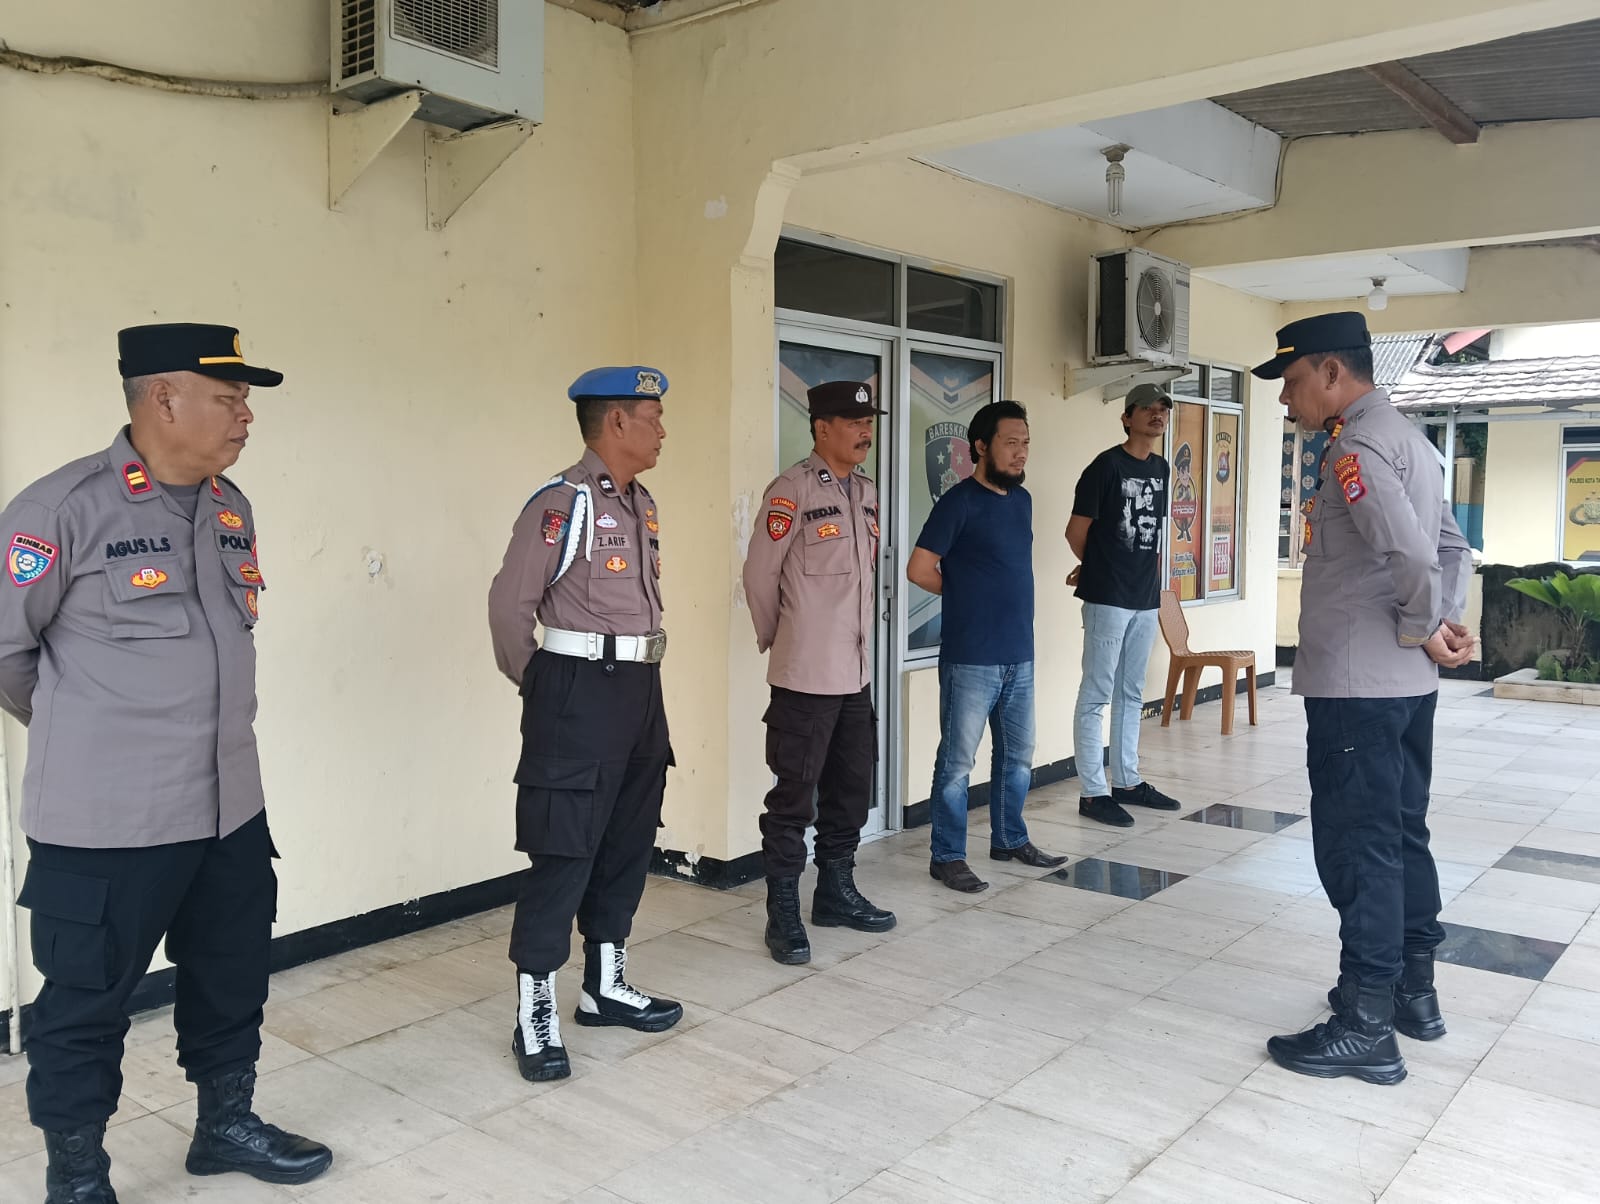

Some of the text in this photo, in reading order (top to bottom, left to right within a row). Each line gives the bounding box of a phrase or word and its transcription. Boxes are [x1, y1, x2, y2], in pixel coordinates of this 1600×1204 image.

[804, 505, 842, 522] TEDJA
[15, 536, 53, 555] BINMAS
[105, 536, 171, 559] AGUS L.S
[597, 536, 627, 547] Z.ARIF
